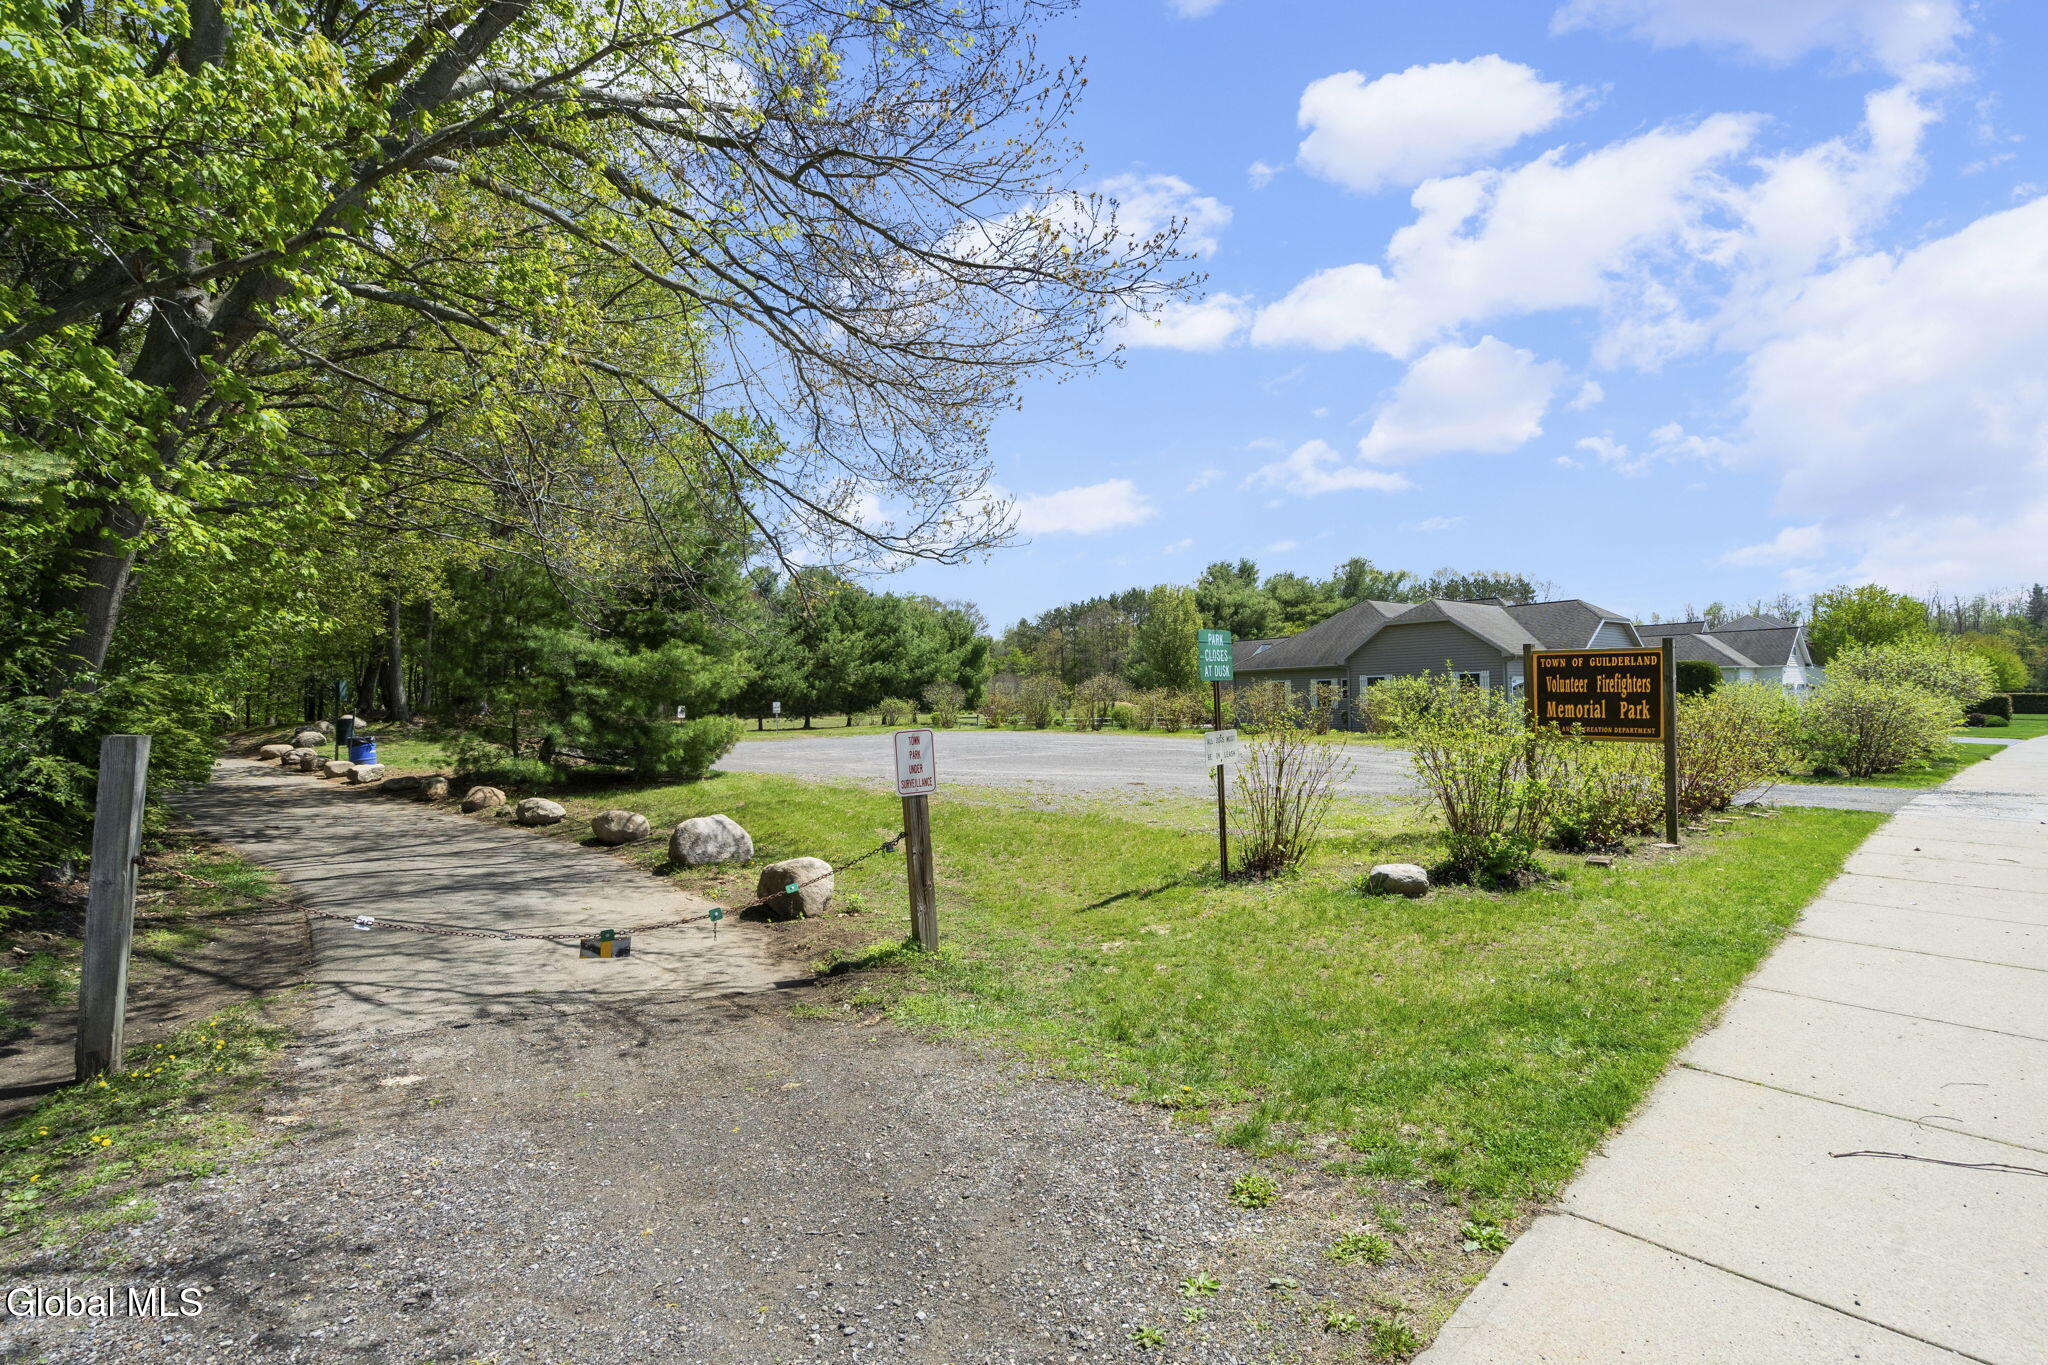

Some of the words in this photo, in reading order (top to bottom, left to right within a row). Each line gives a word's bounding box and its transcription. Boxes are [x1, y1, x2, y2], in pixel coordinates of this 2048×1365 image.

[1208, 633, 1224, 646] PARK
[1204, 649, 1229, 662] CLOSES
[1540, 658, 1566, 668] TOWN
[1572, 657, 1584, 667] OF
[1589, 656, 1657, 666] GUILDERLAND
[1204, 665, 1212, 677] AT
[1214, 665, 1230, 677] DUSK
[1546, 674, 1588, 693] Volunteer
[1596, 673, 1651, 698] Firefighters
[1546, 699, 1606, 719] Memorial
[1620, 699, 1651, 719] Park
[1577, 726, 1612, 734] CREATION
[908, 736, 920, 745] TOWN
[909, 750, 921, 760] PARK
[909, 764, 923, 774] UNDER
[901, 777, 932, 789] SURVEILLANCE
